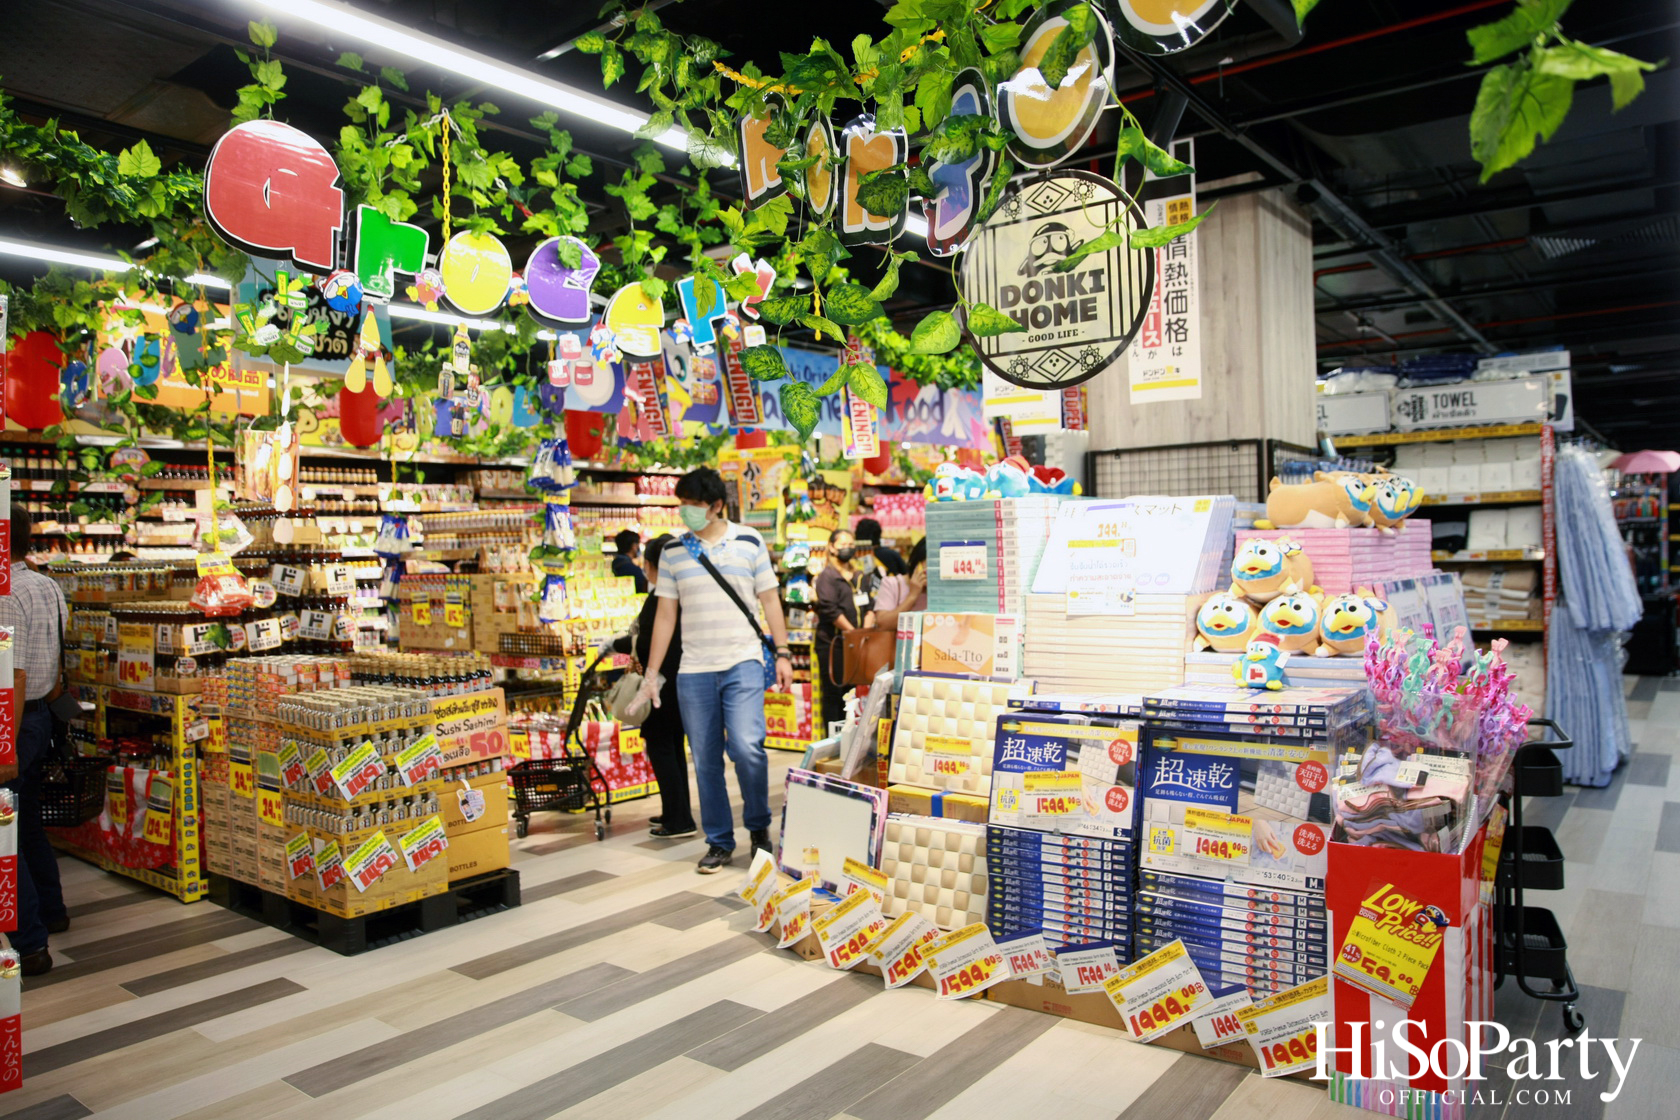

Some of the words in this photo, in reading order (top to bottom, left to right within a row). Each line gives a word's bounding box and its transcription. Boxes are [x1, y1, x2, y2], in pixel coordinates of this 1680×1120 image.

[999, 267, 1106, 309] DONKI
[1008, 296, 1098, 331] HOME
[1028, 332, 1055, 344] GOOD
[1057, 329, 1079, 339] LIFE
[1432, 391, 1478, 409] TOWEL
[934, 649, 983, 662] Sala-Tto
[435, 723, 462, 737] Sushi
[463, 715, 497, 731] Sashimi
[1000, 736, 1063, 764] 超速乾
[1152, 756, 1233, 789] 超速乾
[449, 861, 478, 873] BOTTLES
[1309, 877, 1318, 889] M
[1361, 883, 1424, 917] Low
[1342, 952, 1358, 962] OFF
[1382, 943, 1396, 955] Cloth
[1402, 951, 1417, 965] Piece
[2, 1018, 21, 1085] こんなの
